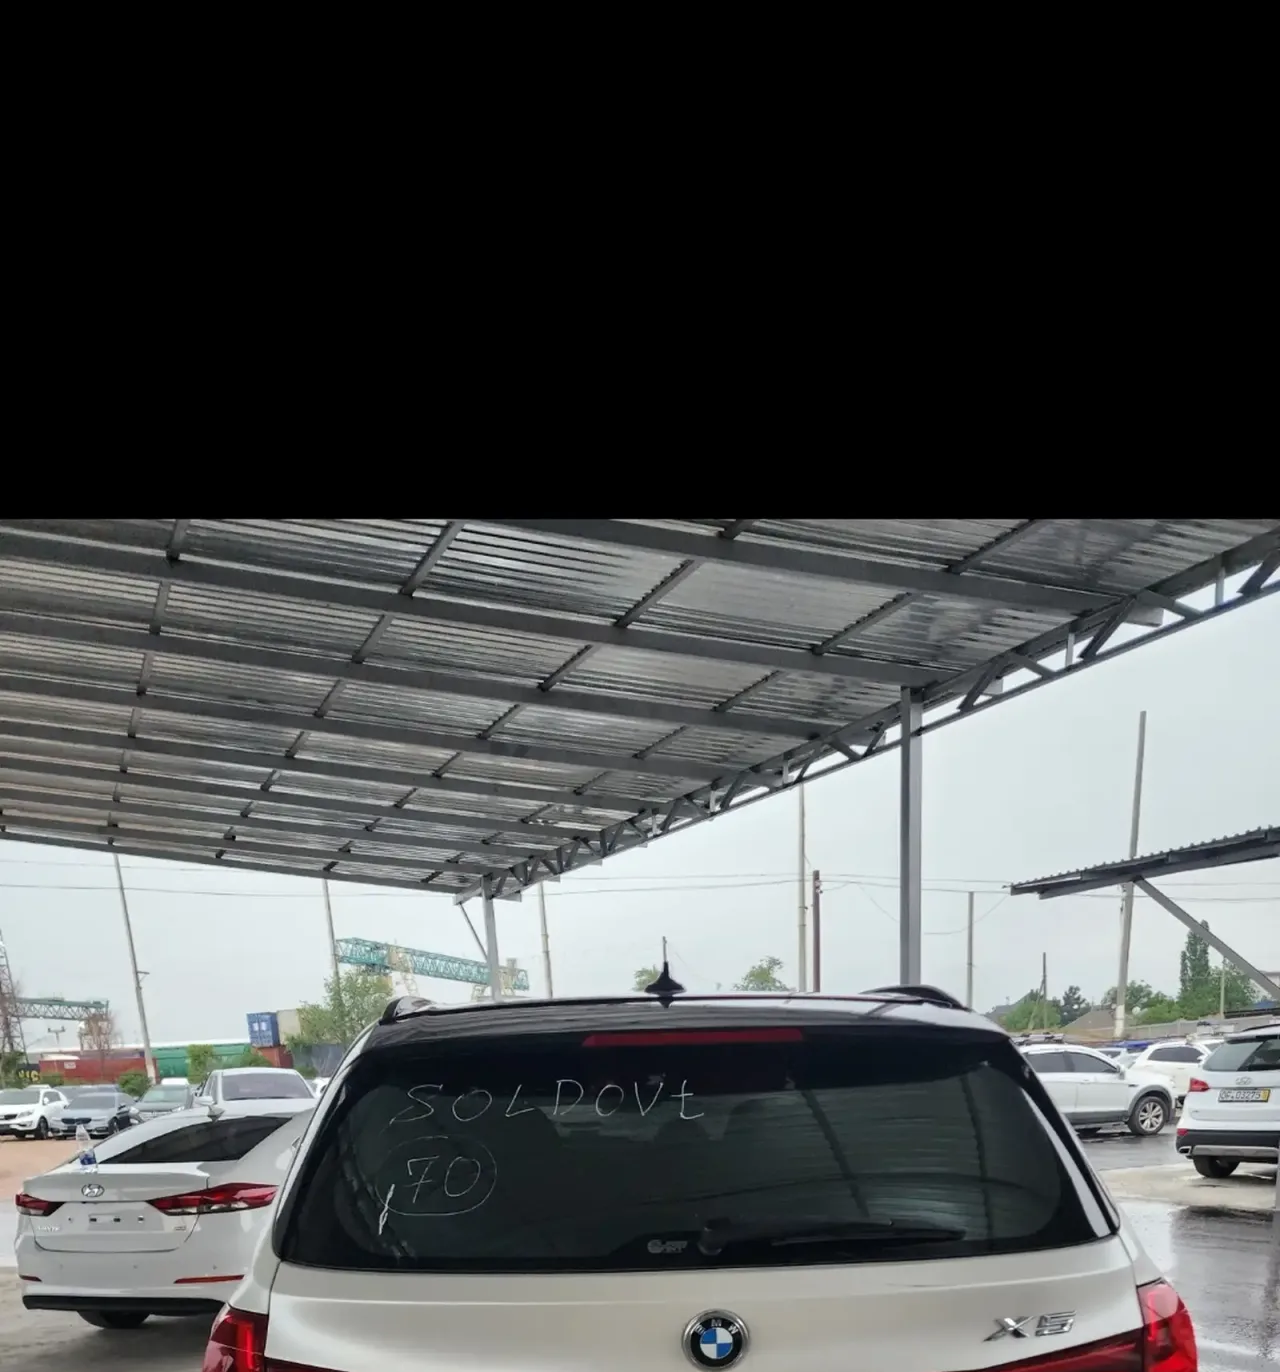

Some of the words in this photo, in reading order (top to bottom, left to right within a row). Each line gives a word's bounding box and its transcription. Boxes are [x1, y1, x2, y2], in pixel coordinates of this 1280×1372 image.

[406, 1155, 481, 1204] 70
[694, 1318, 739, 1336] BMW
[983, 1310, 1078, 1342] X5
